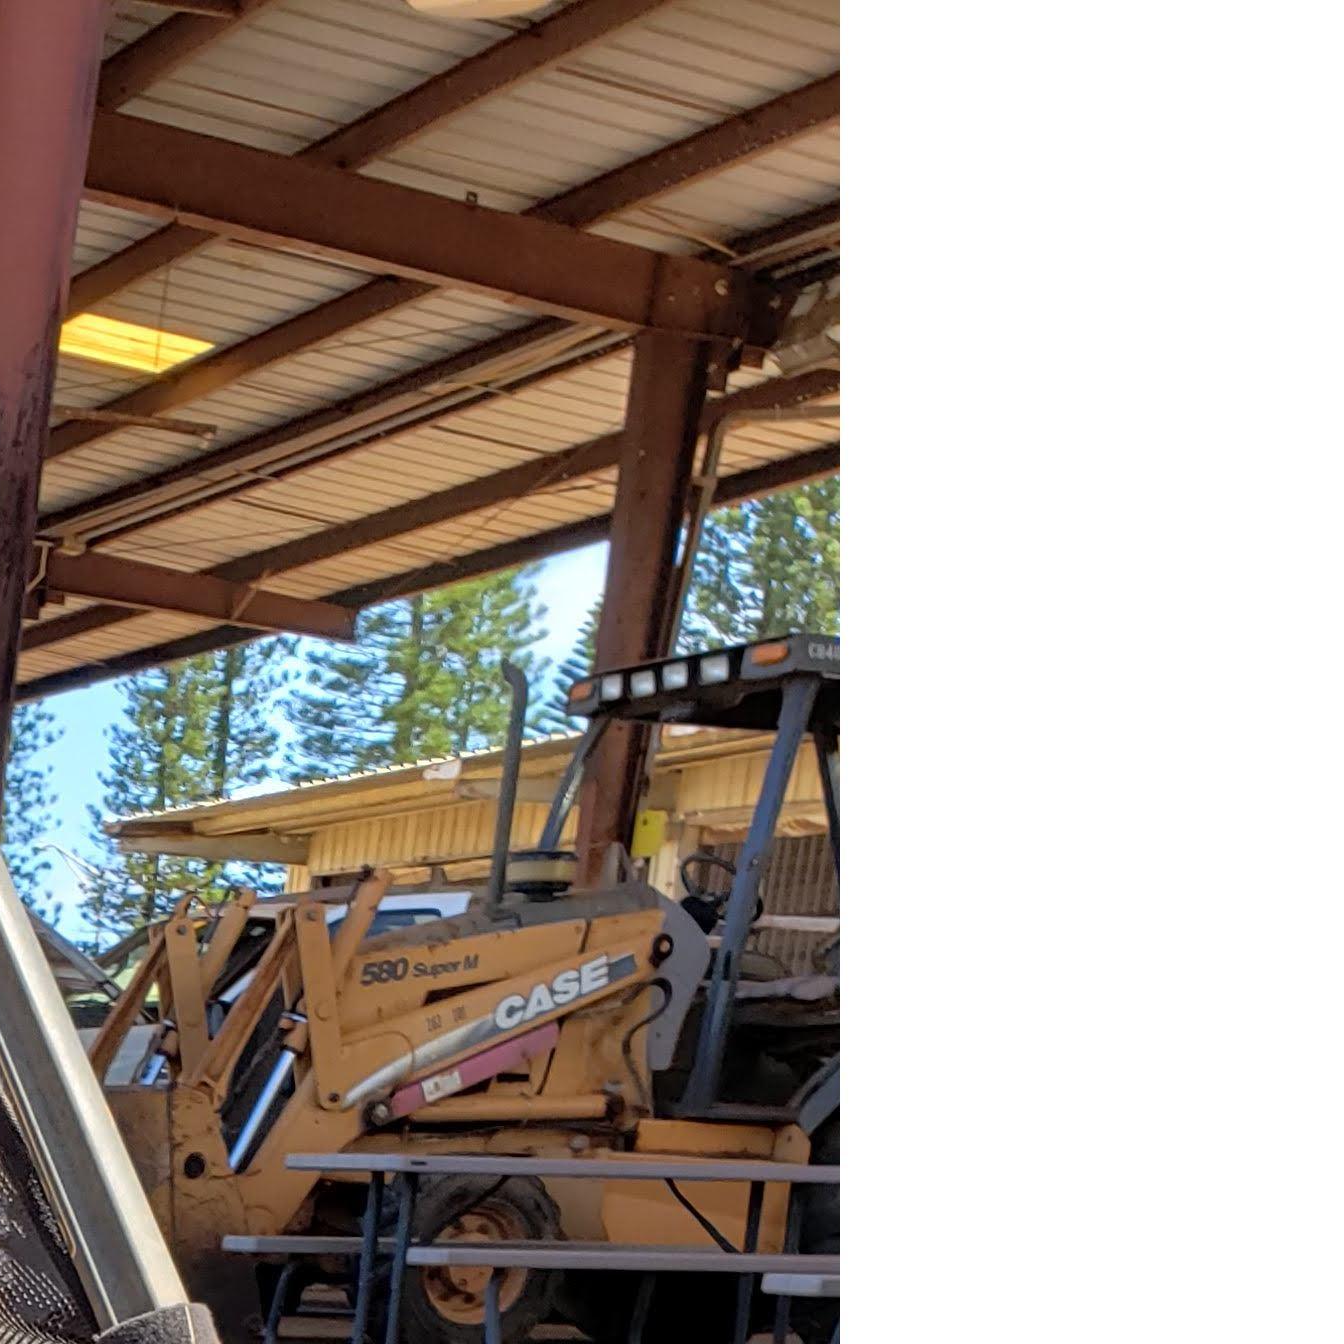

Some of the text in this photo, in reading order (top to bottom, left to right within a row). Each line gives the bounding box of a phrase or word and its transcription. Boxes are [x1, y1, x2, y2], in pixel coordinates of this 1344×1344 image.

[360, 954, 480, 985] 580 Super M
[494, 953, 611, 1031] CASE
